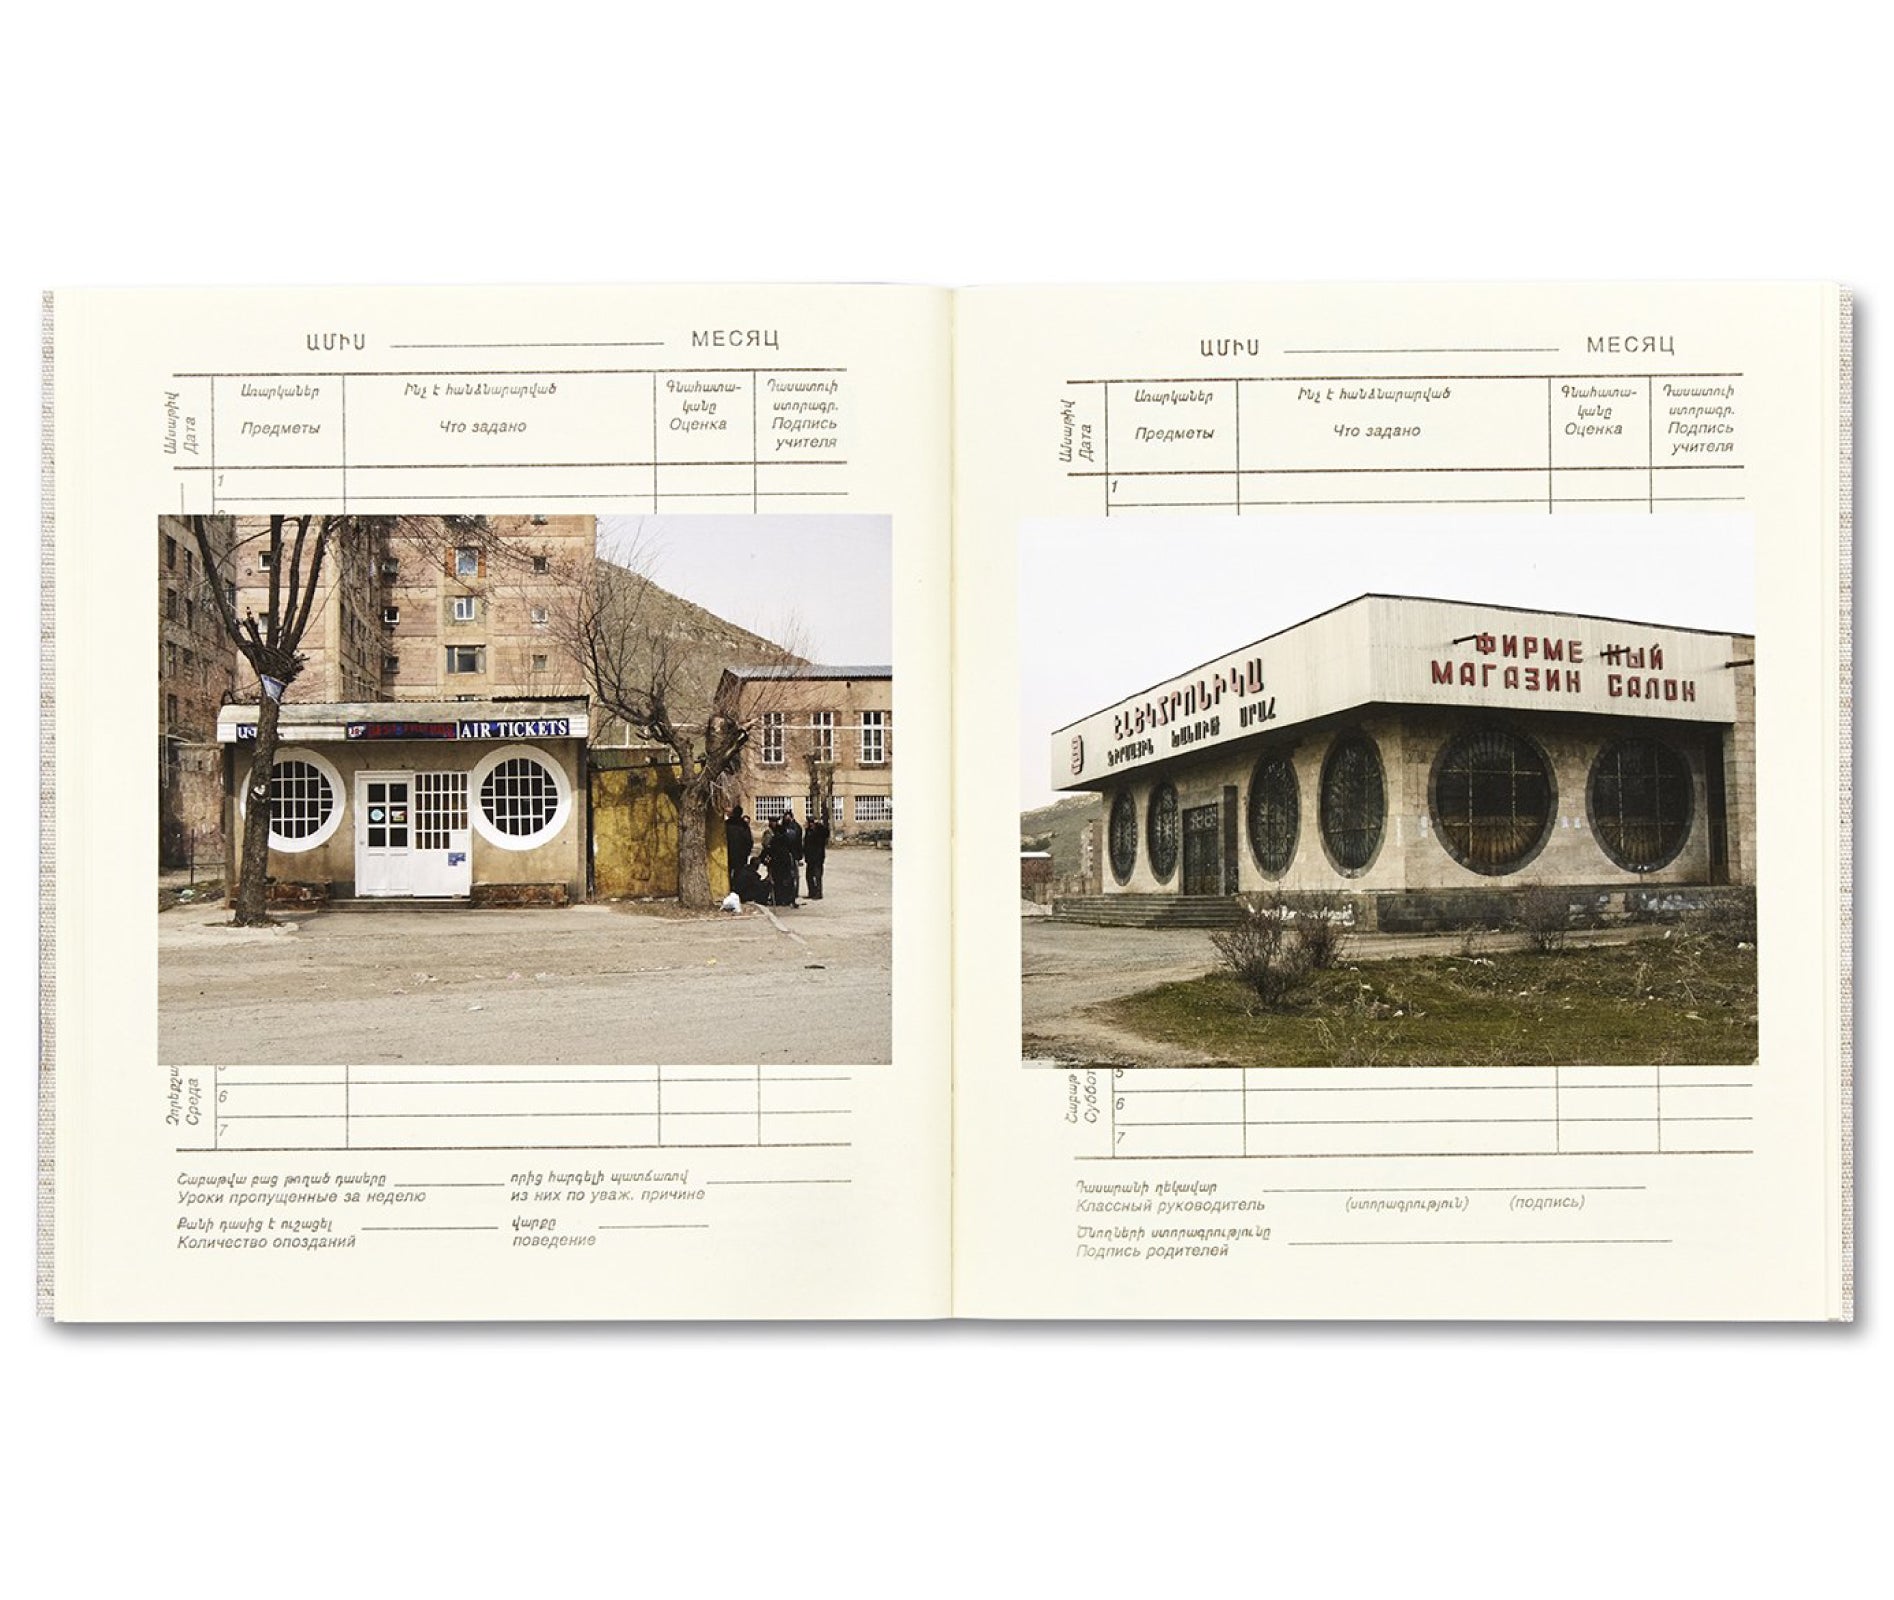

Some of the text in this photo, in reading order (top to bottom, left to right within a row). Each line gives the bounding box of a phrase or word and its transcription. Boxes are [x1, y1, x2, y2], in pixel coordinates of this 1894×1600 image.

[307, 333, 365, 351] ԱՄԻՍ
[692, 330, 779, 350] МЕСЯЦ
[1201, 339, 1259, 357] ԱՄԻՍ
[1587, 336, 1674, 356] МЕСЯЦ
[241, 421, 321, 437] Предметы
[440, 421, 527, 435] Что задано
[669, 414, 727, 433] Оценка
[772, 417, 837, 432] Подпись
[1334, 424, 1421, 439] Что задано
[1564, 422, 1622, 437] Оценка
[1668, 421, 1734, 437] Подпись
[183, 417, 199, 455] Дата
[1135, 427, 1215, 443] Предметы
[776, 438, 837, 451] учителя
[1078, 424, 1094, 463] Дата
[1671, 442, 1734, 456] учителя
[1112, 480, 1118, 493] 1
[1474, 632, 1665, 671] ФИРМЕ НЫЙ
[1430, 660, 1697, 703] МАГАЗИН САЛОН
[461, 722, 492, 738] AIR
[498, 720, 568, 738] TICKETS
[185, 1078, 202, 1125] Среда
[218, 1090, 228, 1103] 6
[1084, 1070, 1100, 1124] Суббот
[1116, 1097, 1125, 1110] 6
[220, 1124, 228, 1136] 7
[1116, 1132, 1126, 1144] 7
[178, 1191, 426, 1206] Уроки пропущенные за неделю
[511, 1190, 705, 1203] из них по уваж. причине
[1510, 1195, 1585, 1211] (подпись)
[1077, 1199, 1265, 1214] Классный руководитель
[177, 1235, 356, 1251] Количество опозданий
[513, 1236, 596, 1249] поведение
[1077, 1244, 1228, 1259] Подпись родителей
